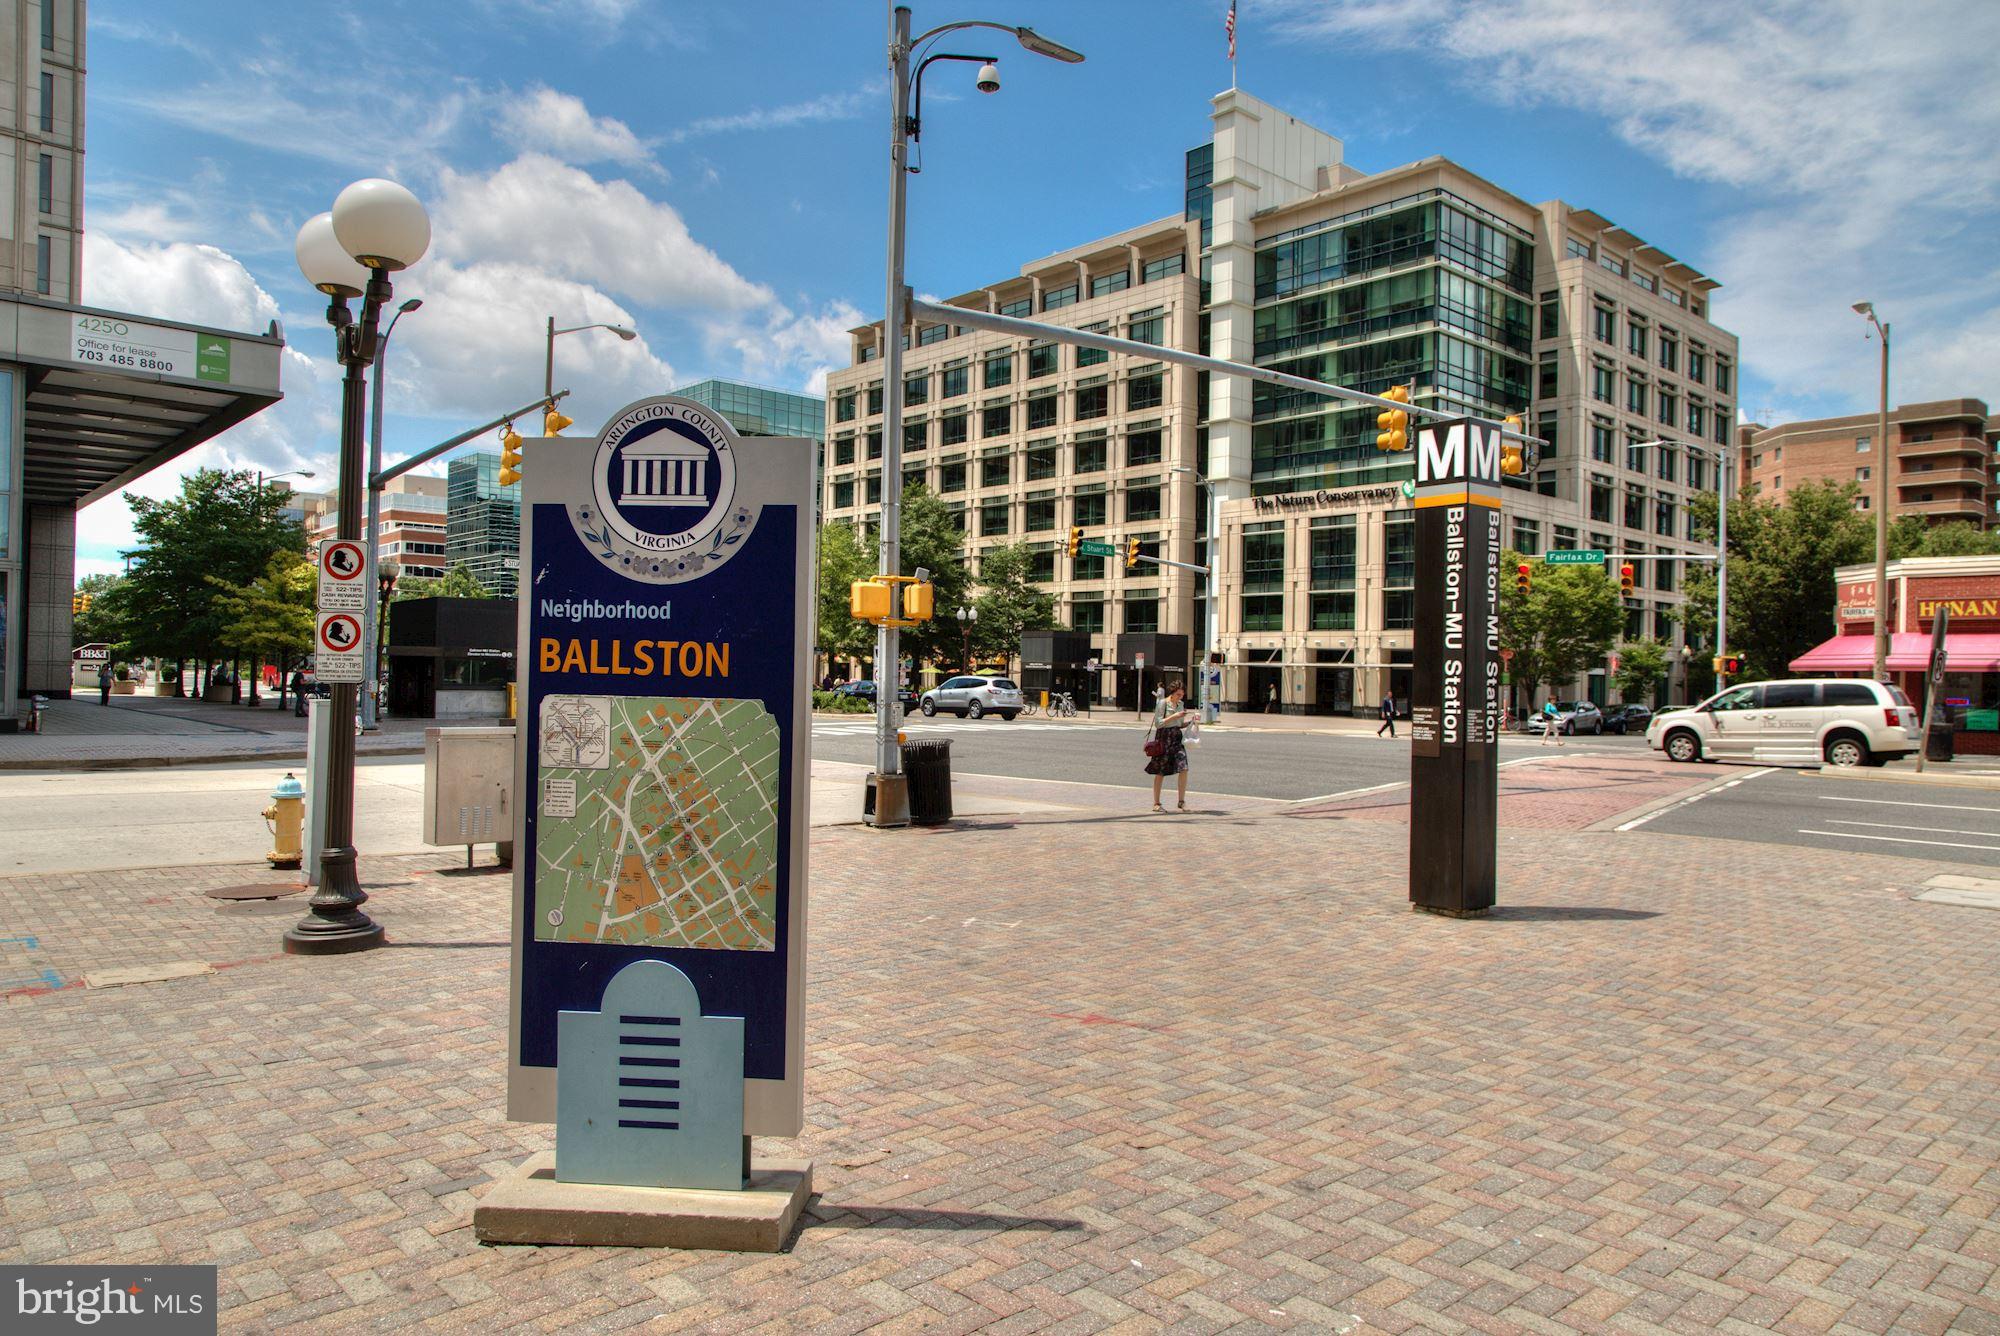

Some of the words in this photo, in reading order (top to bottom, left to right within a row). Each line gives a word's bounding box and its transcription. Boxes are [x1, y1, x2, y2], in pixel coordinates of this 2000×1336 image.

[78, 317, 129, 336] 4250
[78, 338, 109, 351] Office
[112, 343, 126, 353] for
[128, 345, 157, 358] lease
[77, 349, 104, 362] 703
[109, 354, 134, 366] 485
[140, 358, 174, 372] 8800
[605, 405, 675, 450] ARLINGTON
[682, 408, 728, 452] COUNTY
[1418, 424, 1465, 482] M
[1470, 424, 1500, 482] M
[1252, 496, 1274, 510] The
[1276, 495, 1315, 507] Nature
[1316, 486, 1399, 504] Conservancy
[635, 532, 696, 549] VIRGINIA
[1087, 544, 1104, 552] Stuart
[1444, 506, 1464, 650] Ballston-MU
[1487, 510, 1500, 651] Ballston-MU
[540, 599, 671, 622] Neighborhood
[1920, 600, 1998, 617] HNAN
[80, 650, 107, 658] BB&T
[540, 638, 730, 678] BALLSTON
[1443, 660, 1462, 744] Station
[1486, 661, 1498, 744] Station
